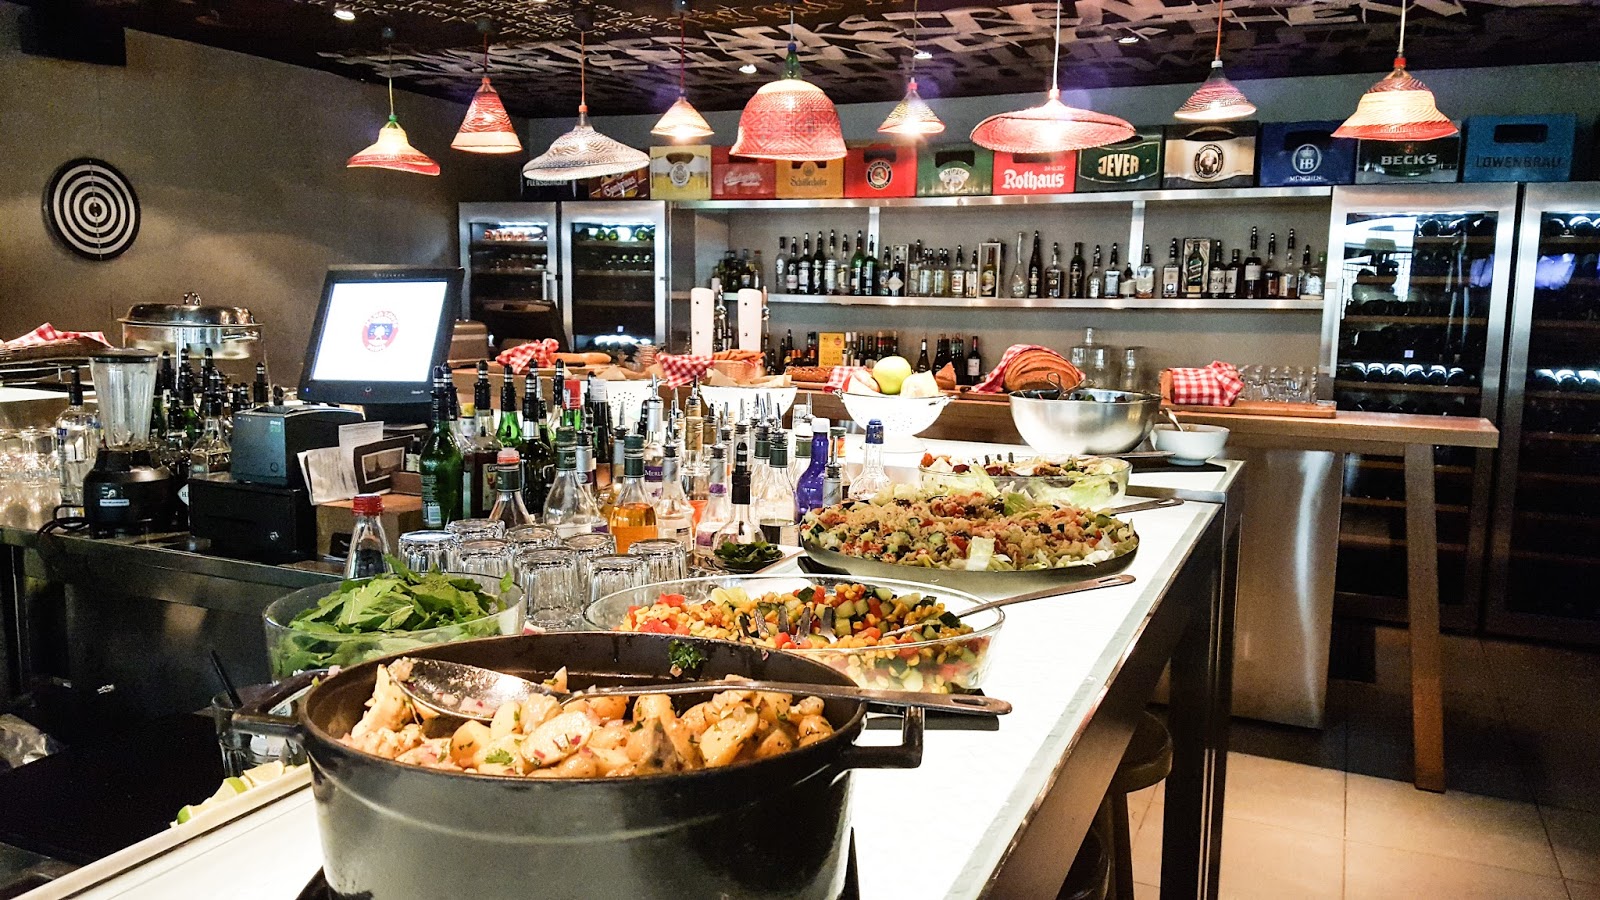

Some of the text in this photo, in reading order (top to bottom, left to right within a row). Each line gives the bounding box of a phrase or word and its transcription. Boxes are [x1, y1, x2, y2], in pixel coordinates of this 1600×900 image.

[1097, 153, 1140, 177] JEVER
[1381, 153, 1437, 166] BECK'S
[1001, 169, 1065, 190] Rothaus
